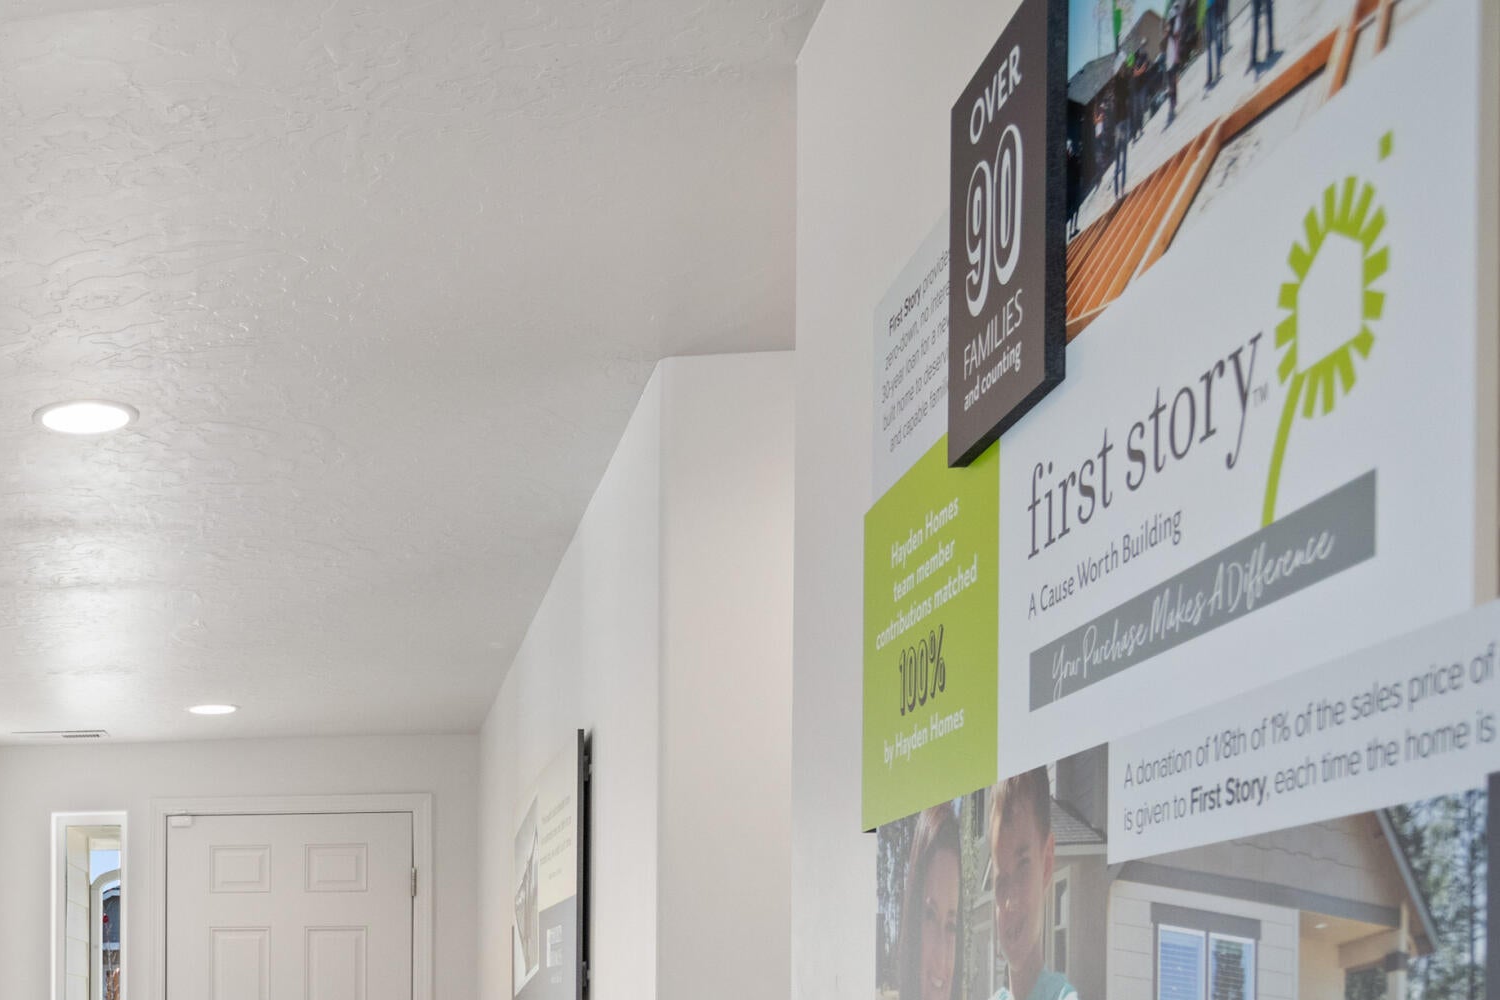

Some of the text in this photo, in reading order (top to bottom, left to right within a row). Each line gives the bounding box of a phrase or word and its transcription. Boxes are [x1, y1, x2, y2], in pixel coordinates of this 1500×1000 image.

[969, 44, 1023, 145] OVER
[965, 124, 1023, 318] 90
[888, 249, 950, 336] First Story provide
[930, 279, 950, 314] intere
[964, 288, 1024, 380] FAMILIES
[915, 376, 923, 394] to
[923, 350, 949, 386] deserv
[964, 341, 1023, 411] and counting
[1027, 428, 1113, 560] first
[1126, 332, 1263, 491] story
[891, 497, 959, 569] Hayden Homes
[893, 539, 955, 603] team member
[1028, 510, 1182, 620] A Cause Worth Building
[876, 553, 978, 651] contributions matched
[1052, 530, 1334, 701] Your Purchase Makes A Difference
[899, 623, 946, 716] 100%
[1124, 641, 1497, 789] A donation of 1/8th of 1% of the sales price of
[883, 708, 965, 769] by Hayden Homes
[1123, 708, 1497, 836] is given to First Story, each time the home is
